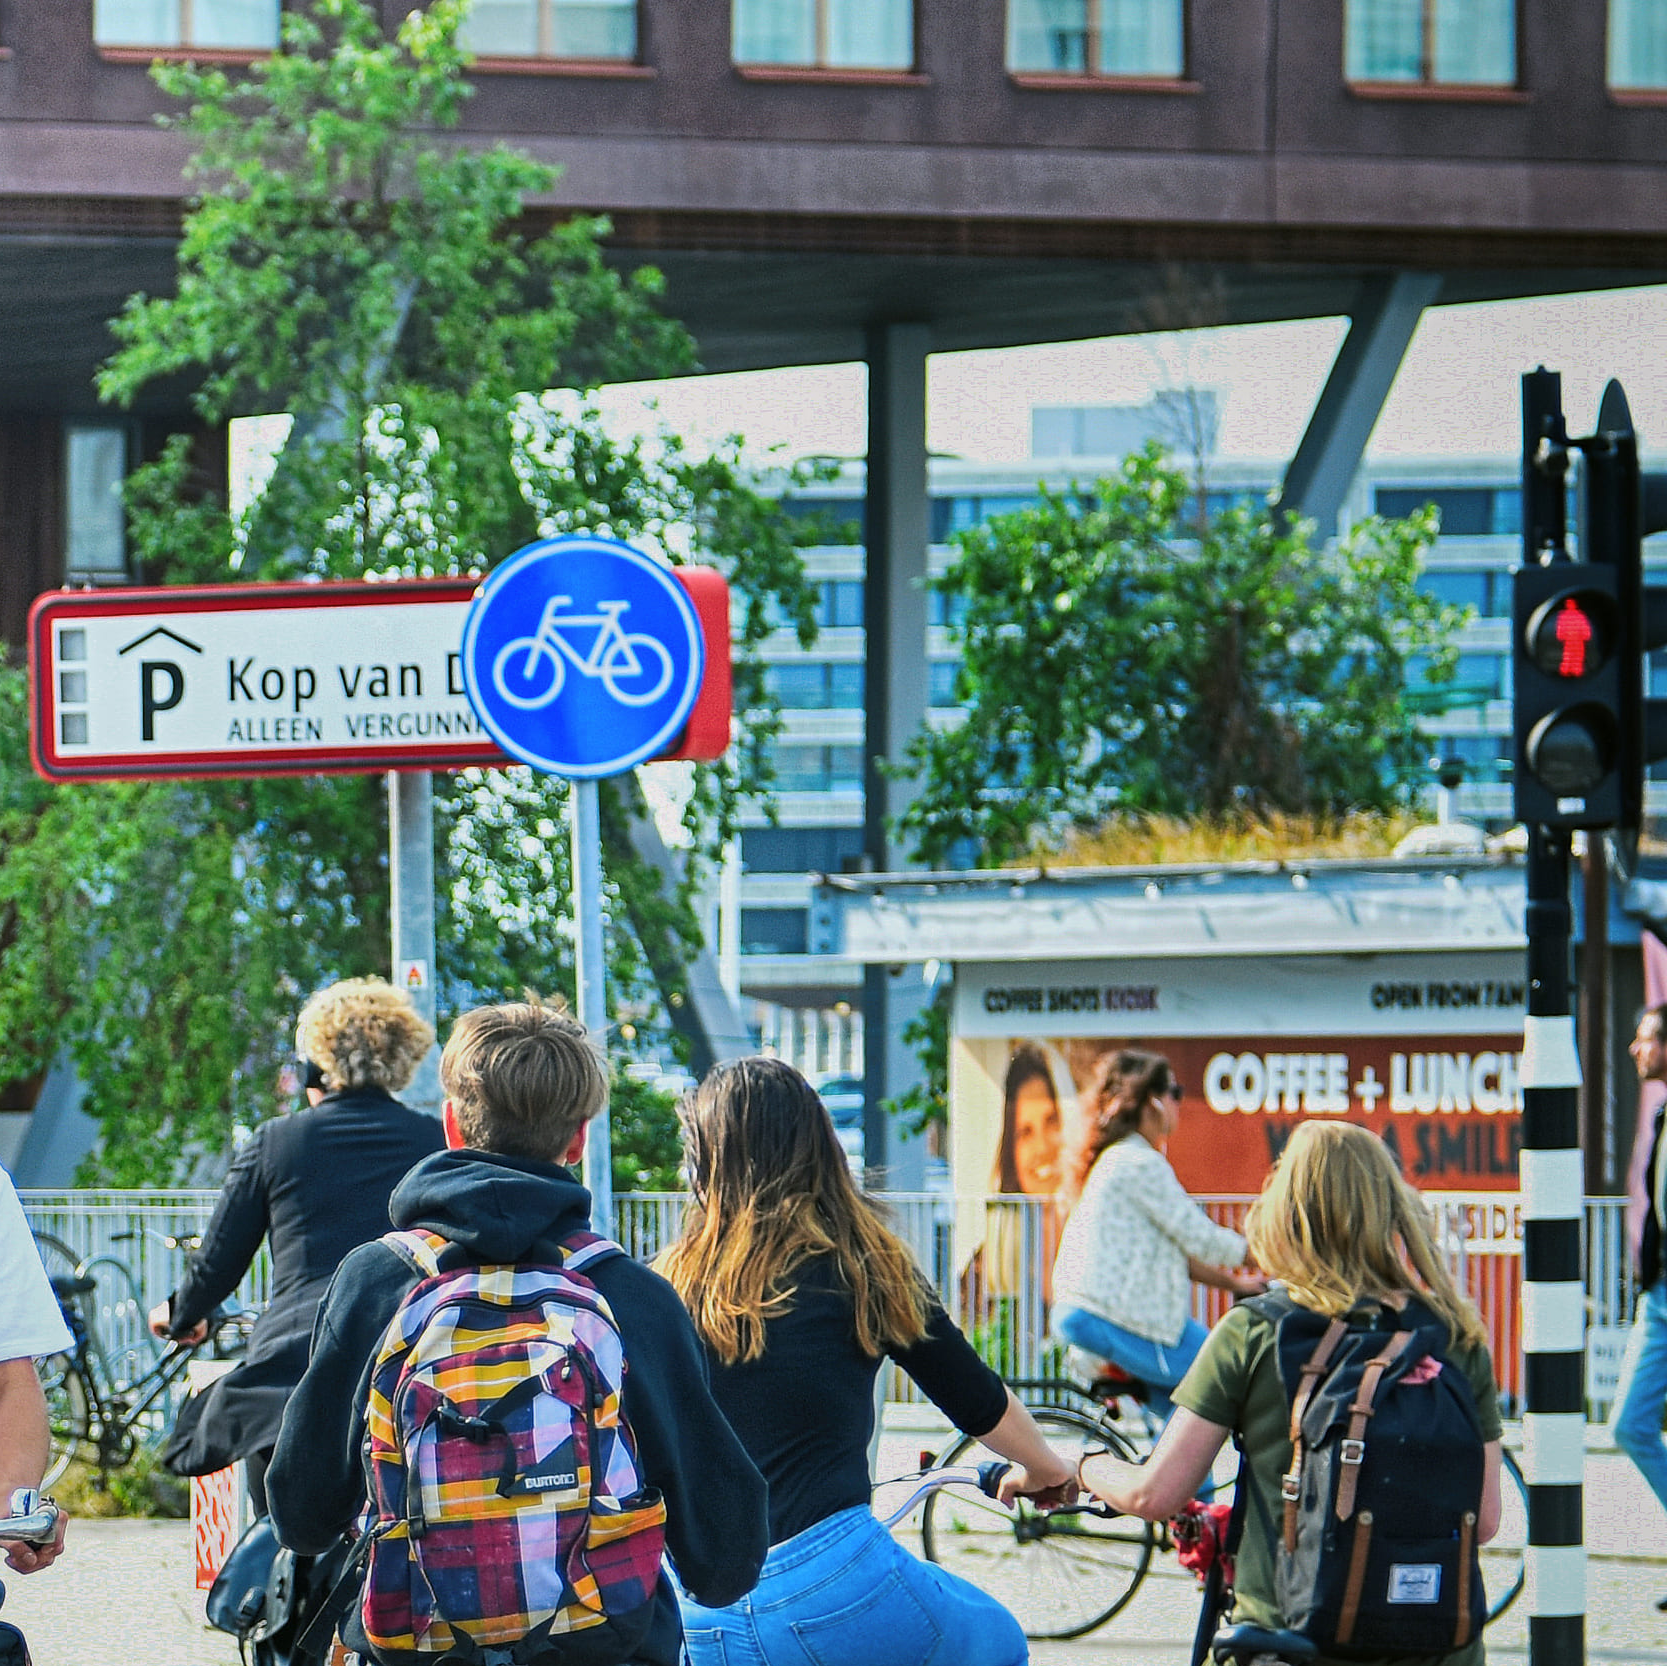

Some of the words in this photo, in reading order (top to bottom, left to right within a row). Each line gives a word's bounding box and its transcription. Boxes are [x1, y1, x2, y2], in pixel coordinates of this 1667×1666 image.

[141, 661, 184, 741] P
[228, 656, 317, 713] Kop
[338, 663, 423, 698] van
[227, 717, 324, 742] ALLEEN
[1372, 985, 1422, 1009] OPEN
[1204, 1052, 1349, 1114] COFFEE
